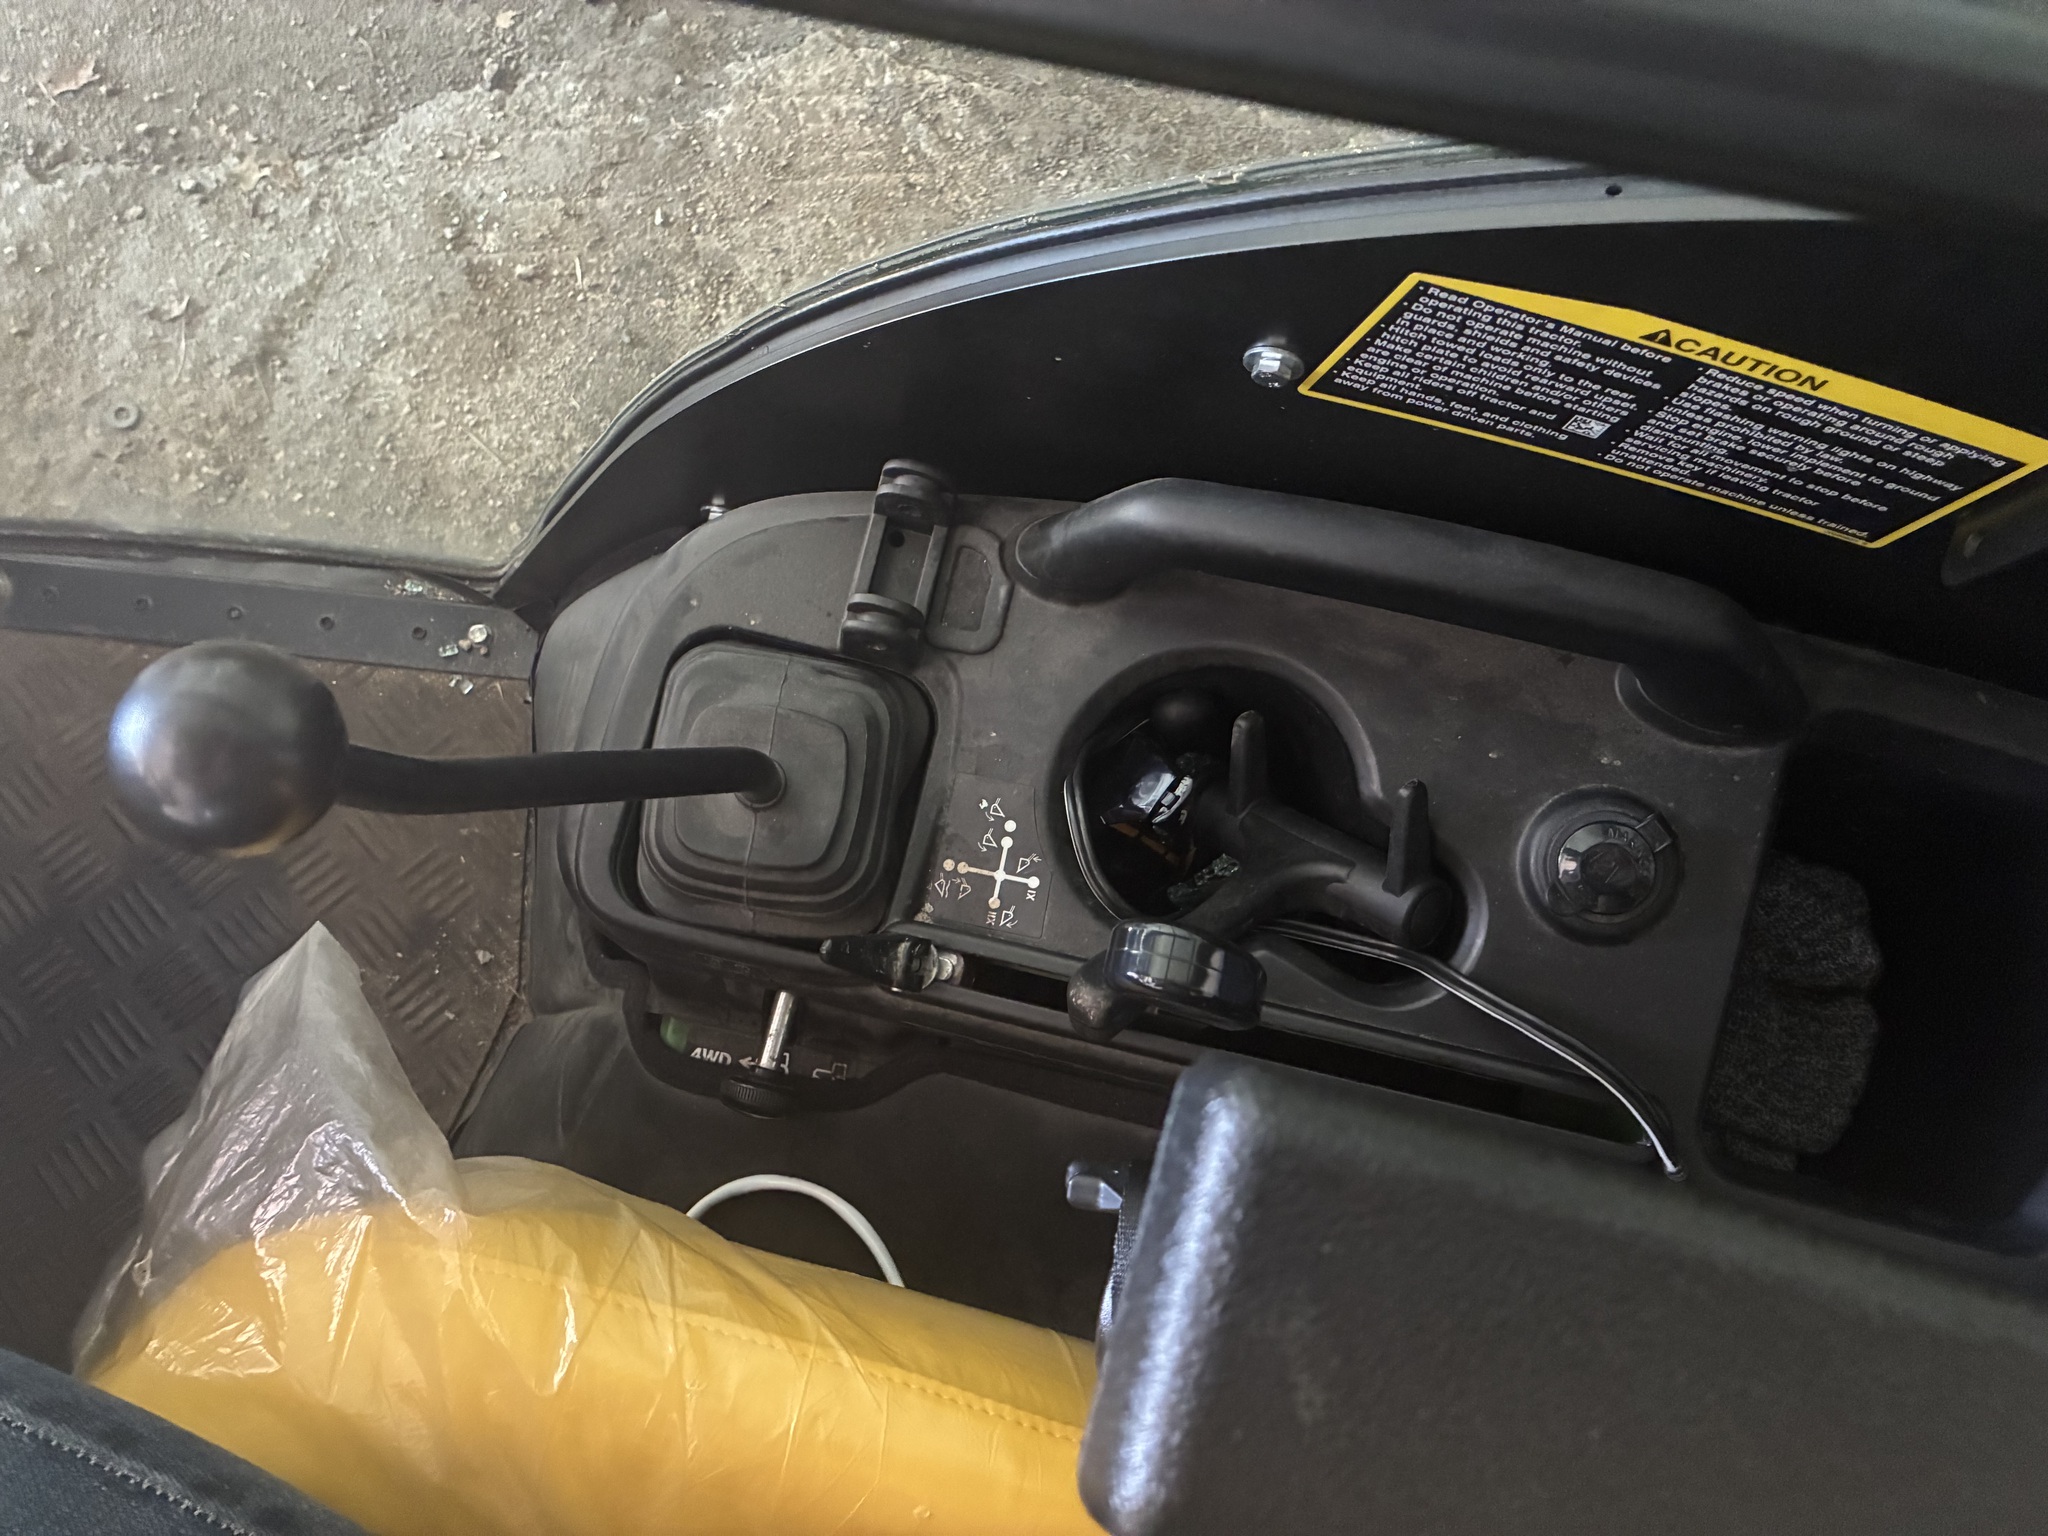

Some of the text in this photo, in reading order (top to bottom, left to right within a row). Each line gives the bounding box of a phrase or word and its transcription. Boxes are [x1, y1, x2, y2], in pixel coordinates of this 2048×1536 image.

[1395, 317, 1551, 369] in place and working.
[1403, 311, 1661, 391] guards, shields and safety devices
[1411, 302, 1653, 378] Do not operate machine without
[1419, 296, 1581, 348] operating this tractor.
[1427, 287, 1672, 364] Read Operator's Manual before
[1347, 365, 1422, 392] equipment.
[1353, 358, 1557, 421] Keep all riders off tractor and
[1360, 353, 1499, 397] engine or operation.
[1366, 346, 1620, 424] are clear of machine before starting
[1374, 338, 1629, 417] Make certain children and/or others
[1381, 331, 1637, 412] hitch plate to avoid rearward upset.
[1388, 324, 1636, 401] Hitch towed loads only to the rear
[1674, 338, 1829, 391] CAUTION
[1334, 377, 1534, 439] away from power driven parts.
[1340, 370, 1568, 442] Keep all hands, feet, and clothing
[1663, 405, 1843, 465] unless prohibited by law.
[1679, 391, 1732, 412] slopes.
[1687, 383, 1945, 468] hazards on rough ground or steep
[1696, 376, 1955, 461] brakes or operating around rough
[1705, 368, 2006, 468] Reduce speed when turning or applying
[1611, 449, 1690, 476] unattended.
[1618, 442, 1819, 507] Remove key if leaving tractor
[1624, 437, 1767, 484] servicing machinery.
[1633, 429, 1888, 512] Wait for all movement to stop before
[1640, 425, 1728, 456] dismounting.
[1646, 418, 1861, 487] and set brake securely before
[1655, 411, 1940, 503] Stop engine, lower implement to ground
[1671, 397, 1963, 492] Use flashing warning lights on highway
[1603, 453, 1624, 465] Do
[1626, 461, 1651, 473] not
[1652, 469, 1705, 488] operate
[1707, 486, 1766, 506] machine
[1769, 504, 1814, 522] unless
[1817, 518, 1868, 537] trained.
[690, 1047, 732, 1066] 4WD
